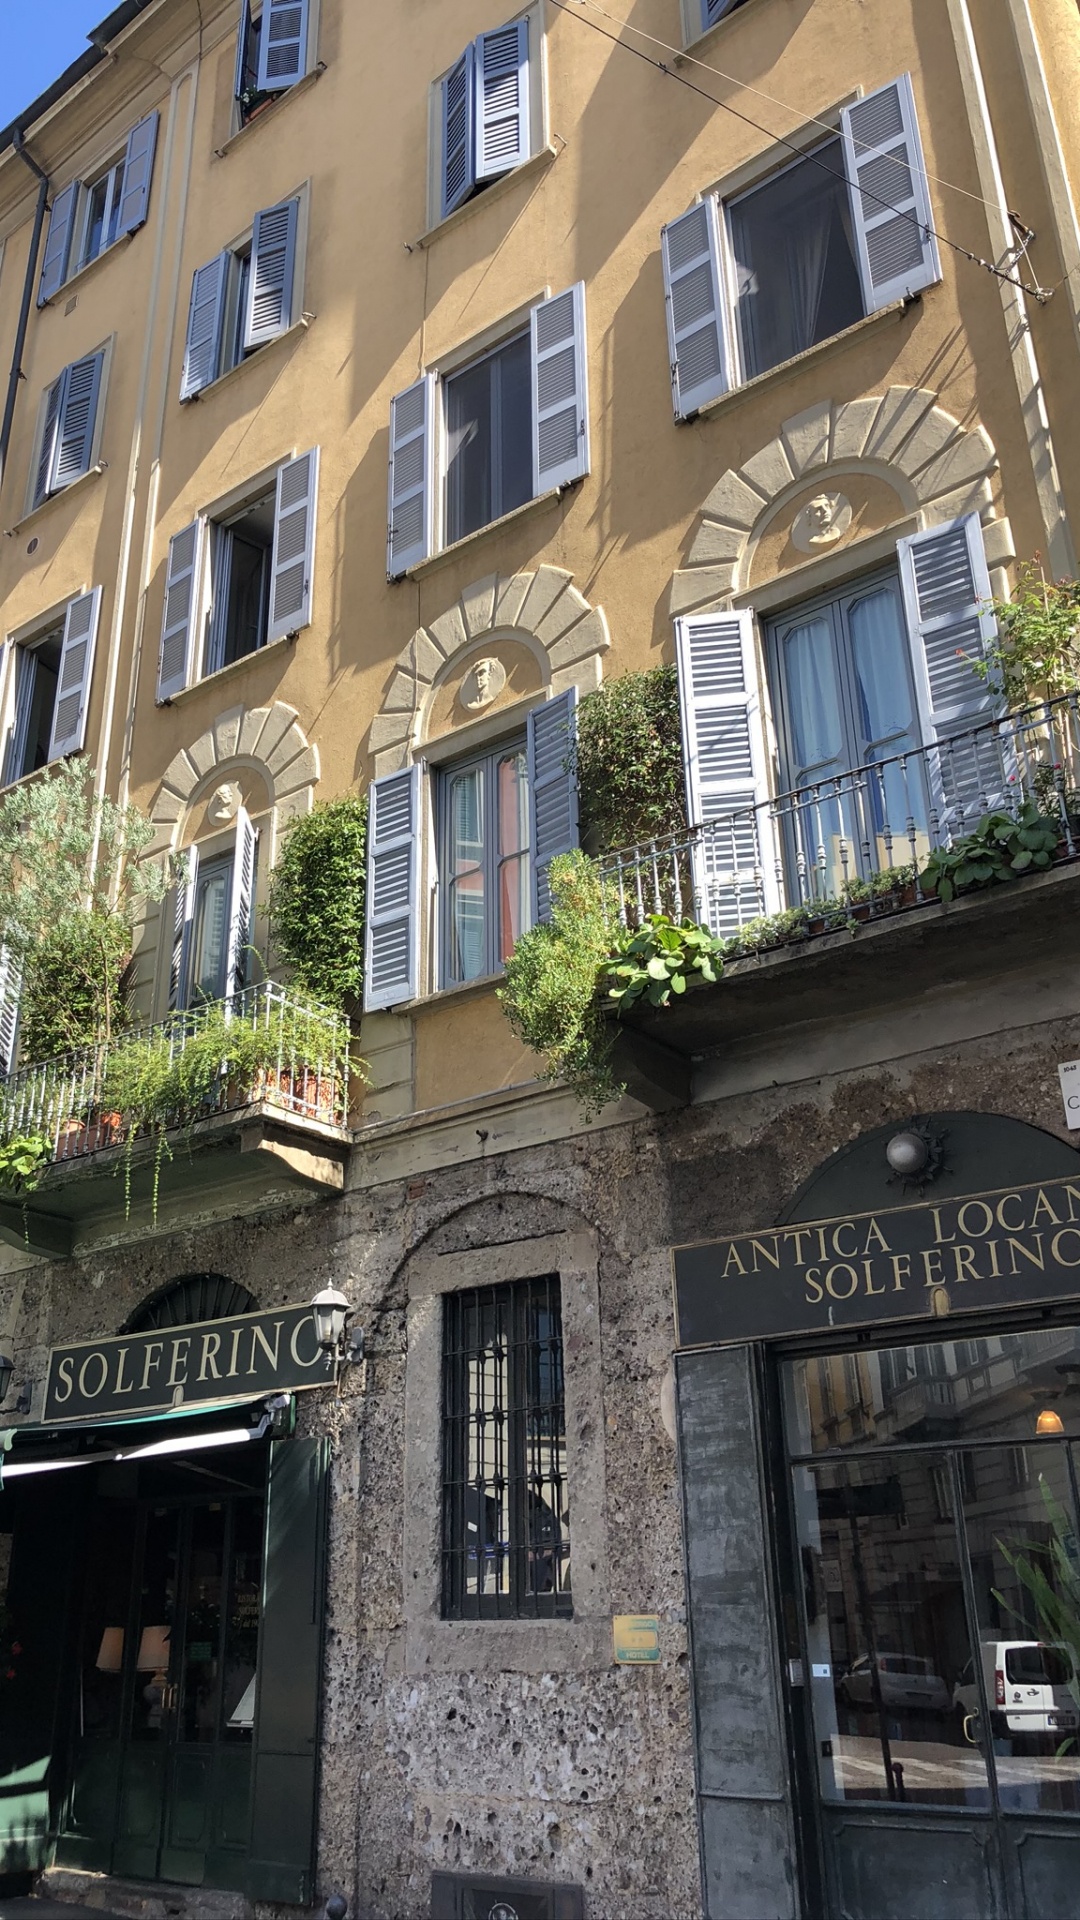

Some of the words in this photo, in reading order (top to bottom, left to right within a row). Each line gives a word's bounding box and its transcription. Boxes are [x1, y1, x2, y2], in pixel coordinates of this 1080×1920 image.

[720, 1217, 893, 1279] ANTICA
[804, 1227, 1080, 1304] SOLFERINO
[54, 1314, 325, 1404] SOLFERINO
